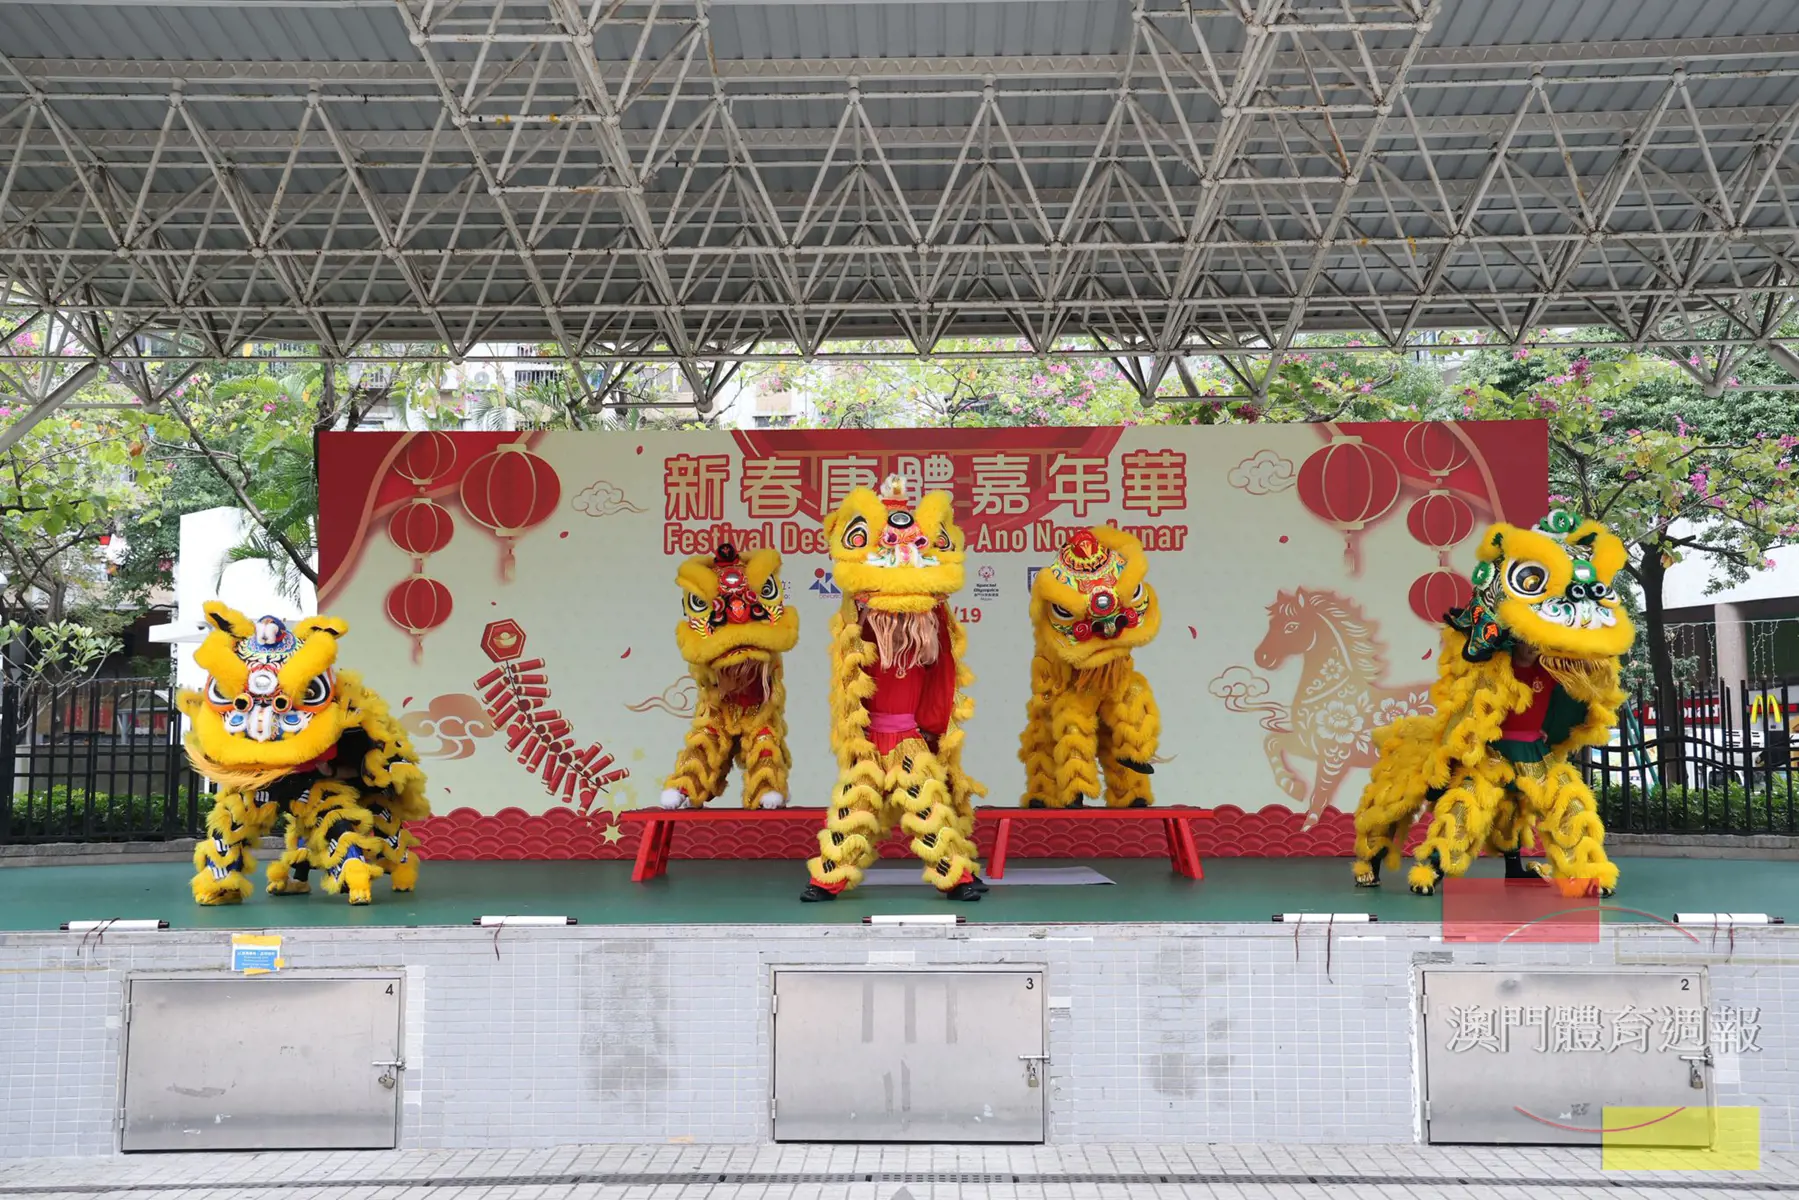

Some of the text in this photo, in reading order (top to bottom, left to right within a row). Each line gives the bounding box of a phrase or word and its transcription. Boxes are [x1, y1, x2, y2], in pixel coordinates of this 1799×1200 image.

[664, 448, 1187, 521] 新春康體嘉年華
[664, 522, 774, 555] Festival
[781, 522, 830, 555] Des
[974, 521, 1027, 552] Ano
[1106, 519, 1188, 551] nar
[385, 983, 394, 996] 4
[1025, 977, 1034, 990] 3
[1680, 978, 1690, 991] 2
